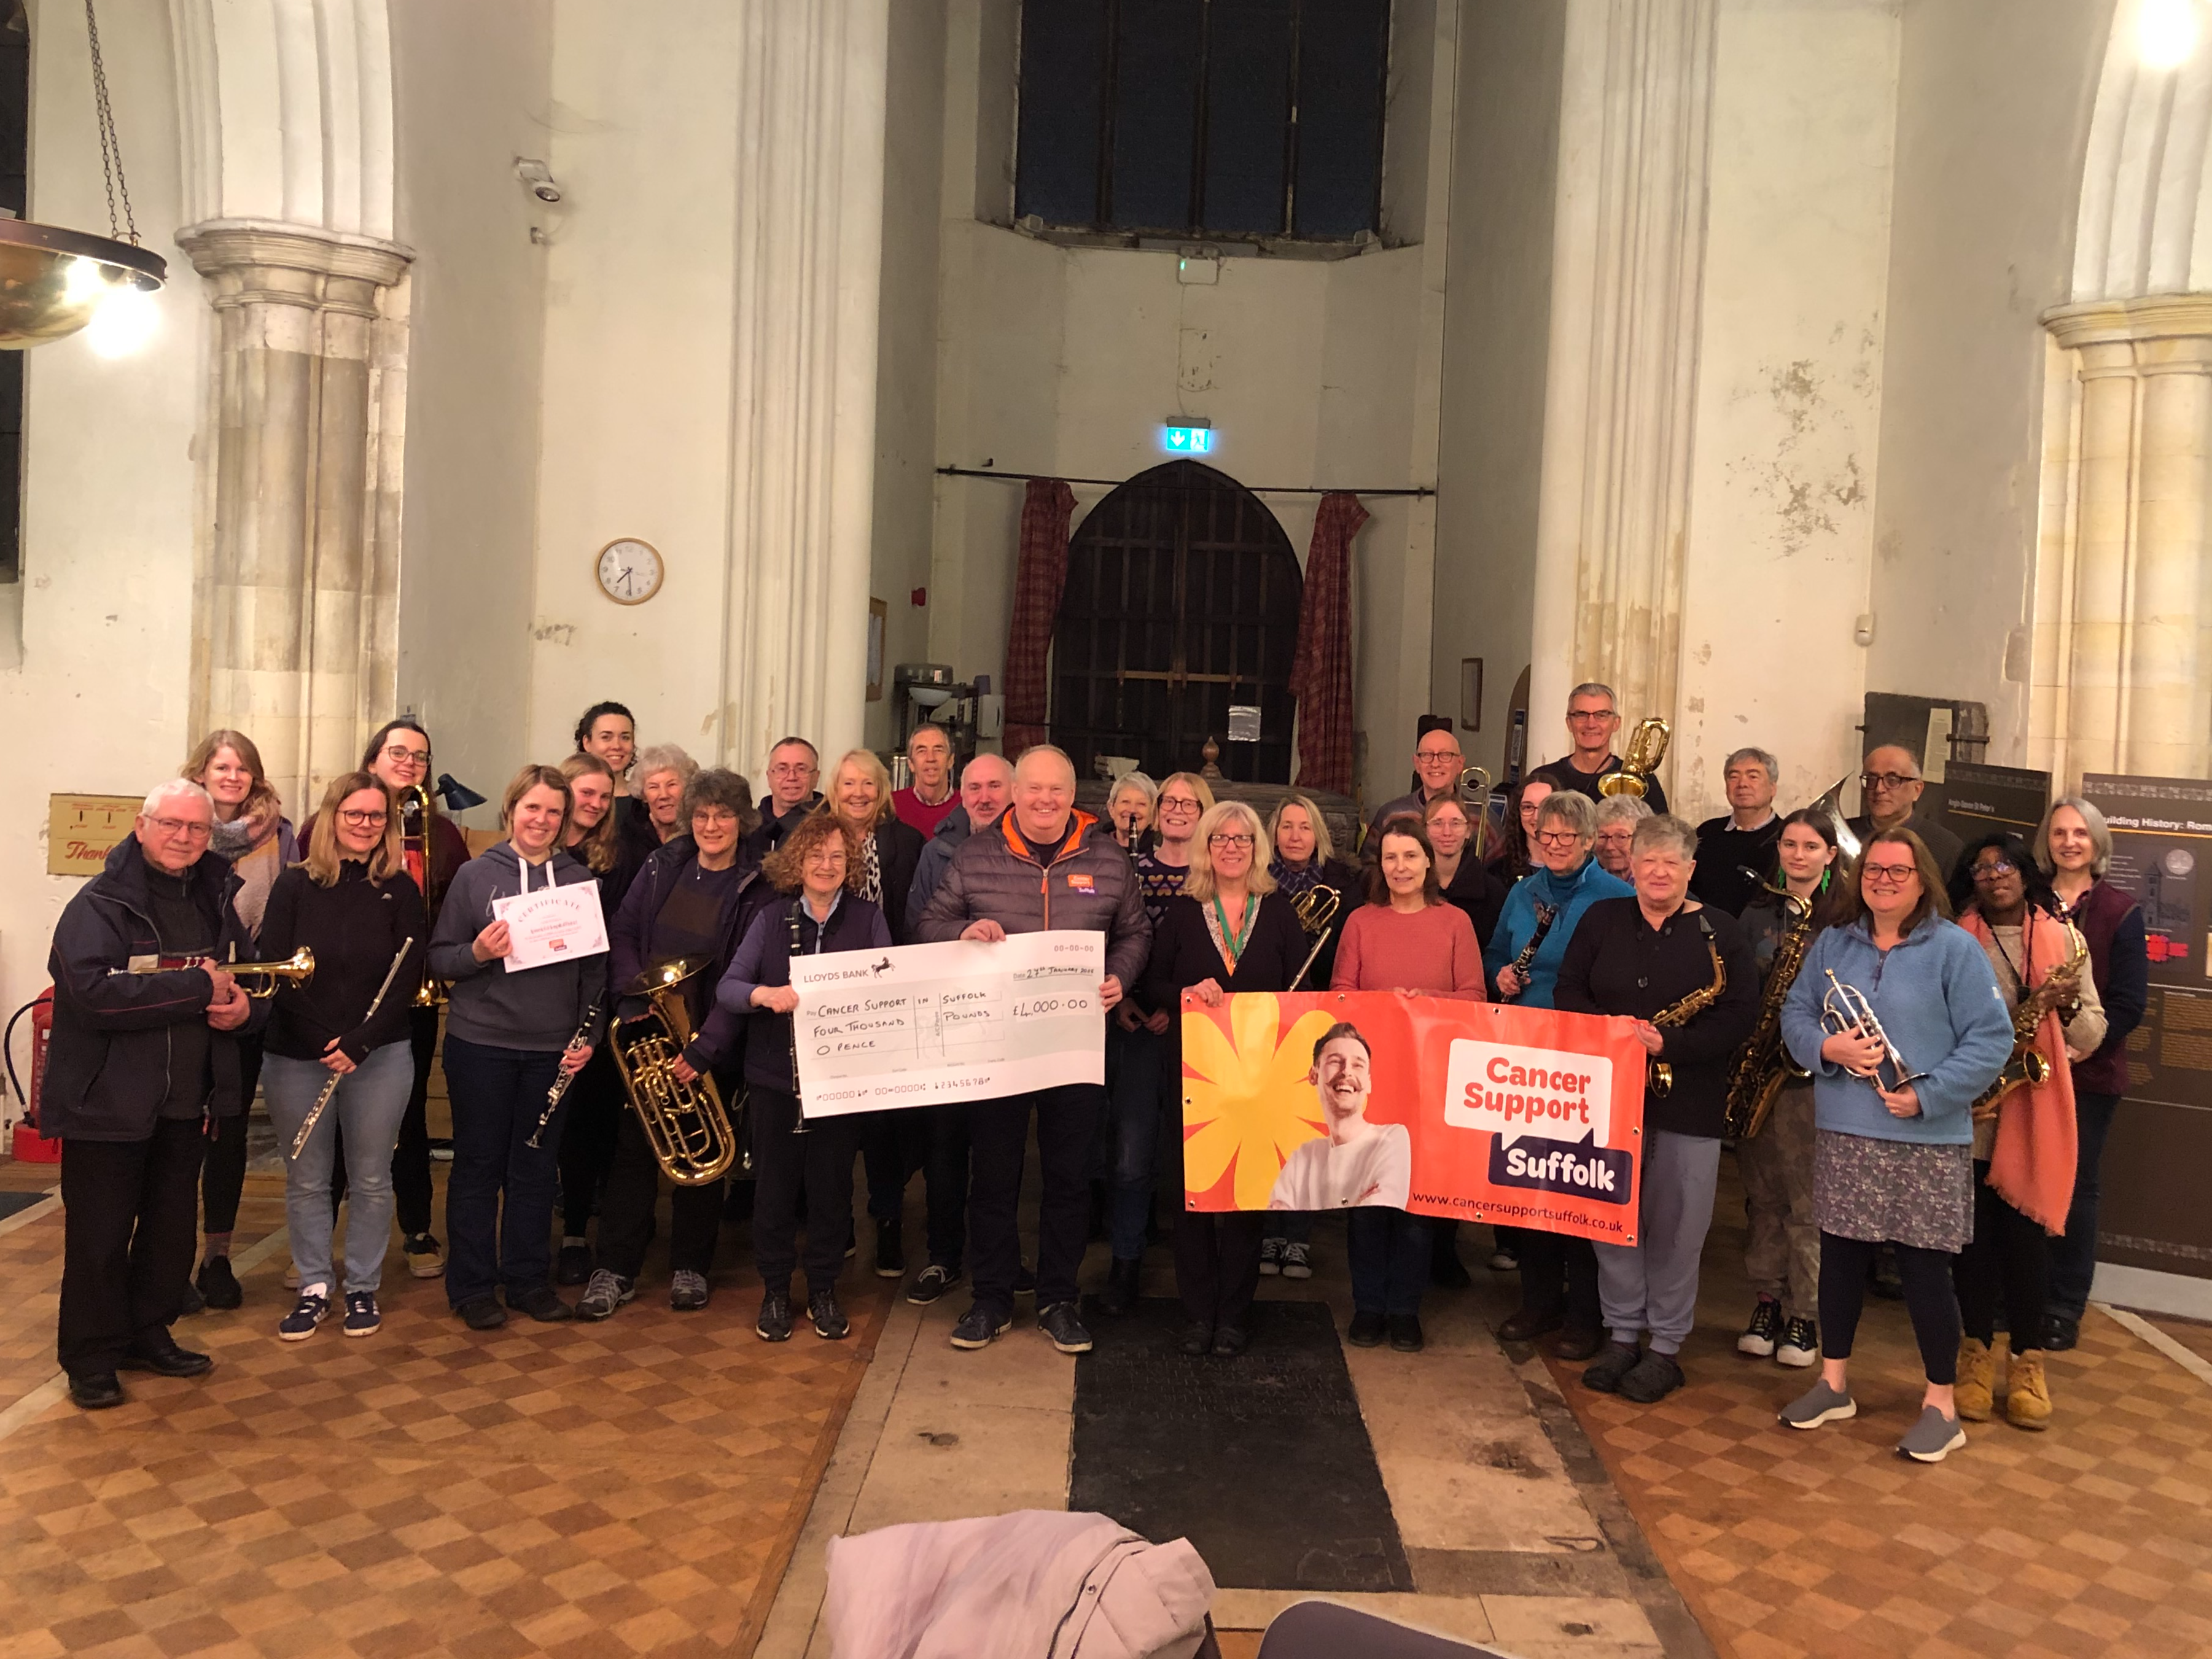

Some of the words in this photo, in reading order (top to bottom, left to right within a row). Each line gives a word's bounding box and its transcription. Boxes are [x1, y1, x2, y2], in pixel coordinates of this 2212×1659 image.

[2103, 815, 2139, 828] uilding
[2141, 818, 2184, 830] History:
[2187, 821, 2212, 831] Rom
[803, 972, 840, 983] LLOYDS
[843, 969, 869, 978] BANK
[818, 1004, 859, 1018] CANCER
[865, 998, 907, 1011] SUPPORT
[943, 992, 986, 1004] SUFFOLK
[813, 1025, 843, 1038] FOUR
[845, 1019, 905, 1032] THOUSAND
[943, 1011, 990, 1021] POUNDS
[837, 1040, 876, 1051] PENCE
[1486, 1057, 1591, 1095] Cancer
[1463, 1082, 1590, 1124] Support
[1506, 1148, 1615, 1192] Suffolk
[1412, 1191, 1623, 1233] www.cancersupportsuffolk.co.uk
